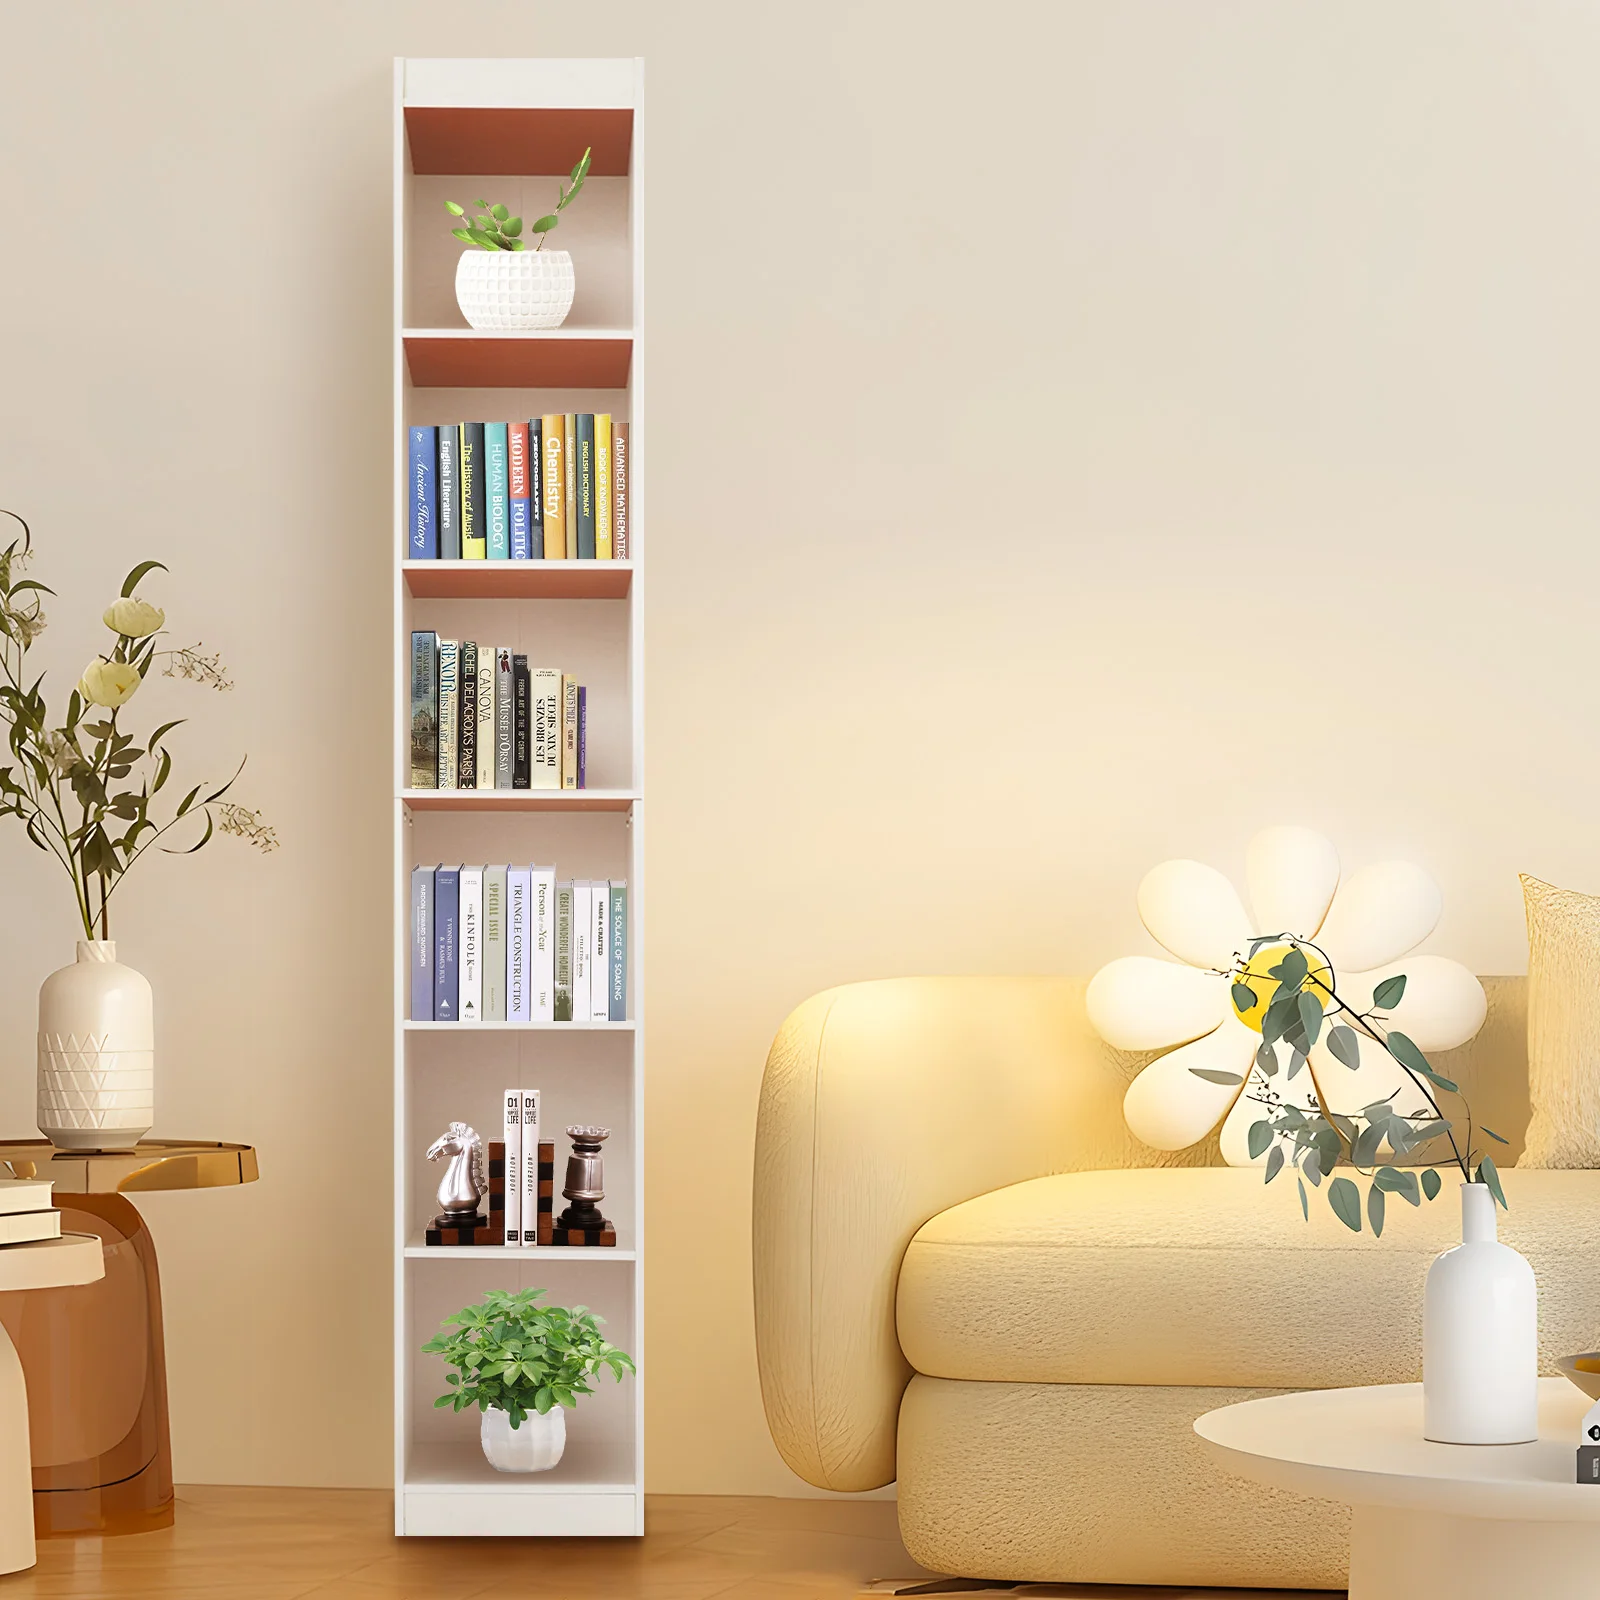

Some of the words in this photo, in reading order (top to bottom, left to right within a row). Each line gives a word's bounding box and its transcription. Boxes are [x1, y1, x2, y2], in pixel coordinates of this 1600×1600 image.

[441, 440, 451, 477] English
[464, 443, 473, 462] The
[492, 444, 502, 492] HUMAN
[512, 433, 525, 495] MODERN
[615, 437, 626, 491] ADVANCED
[417, 455, 429, 502] Ancient
[464, 464, 473, 498] History
[544, 437, 561, 518] Chemistry
[599, 473, 606, 485] OF
[442, 480, 452, 529] Literature
[465, 501, 473, 511] of
[600, 486, 608, 540] KNOWLEDGE
[414, 502, 430, 548] History
[492, 496, 504, 550] BIOLOGY
[514, 503, 526, 559] POLITIC
[616, 493, 626, 559] MATHEMATICS
[440, 641, 457, 693] RENOIR
[464, 641, 476, 679] MICHEL
[478, 668, 492, 723] CANOVA
[500, 679, 508, 697] THE
[535, 698, 545, 742] BRONZES
[546, 695, 556, 729] SIÈCLE
[462, 748, 474, 776] PARIS
[535, 744, 545, 763] LES
[547, 752, 556, 767] DU
[489, 883, 499, 916] SPECIAL
[513, 883, 523, 934] TRIANGLE
[538, 883, 548, 916] Person
[559, 892, 569, 915] CREATE
[615, 896, 623, 912] THE
[466, 914, 475, 967] KINFOLK
[489, 919, 498, 942] ISSUE
[538, 930, 548, 952] Year
[559, 916, 569, 954] WONDERFUL
[614, 915, 622, 947] SOLACE
[559, 955, 569, 986] HOMELIFE
[614, 949, 622, 961] OF
[513, 935, 522, 1012] CONSTRUCTION
[614, 963, 622, 1001] SOAKING
[507, 1097, 518, 1108] 01
[507, 1115, 519, 1124] LIFE
[525, 1097, 536, 1108] 01
[525, 1115, 537, 1124] LIFE
